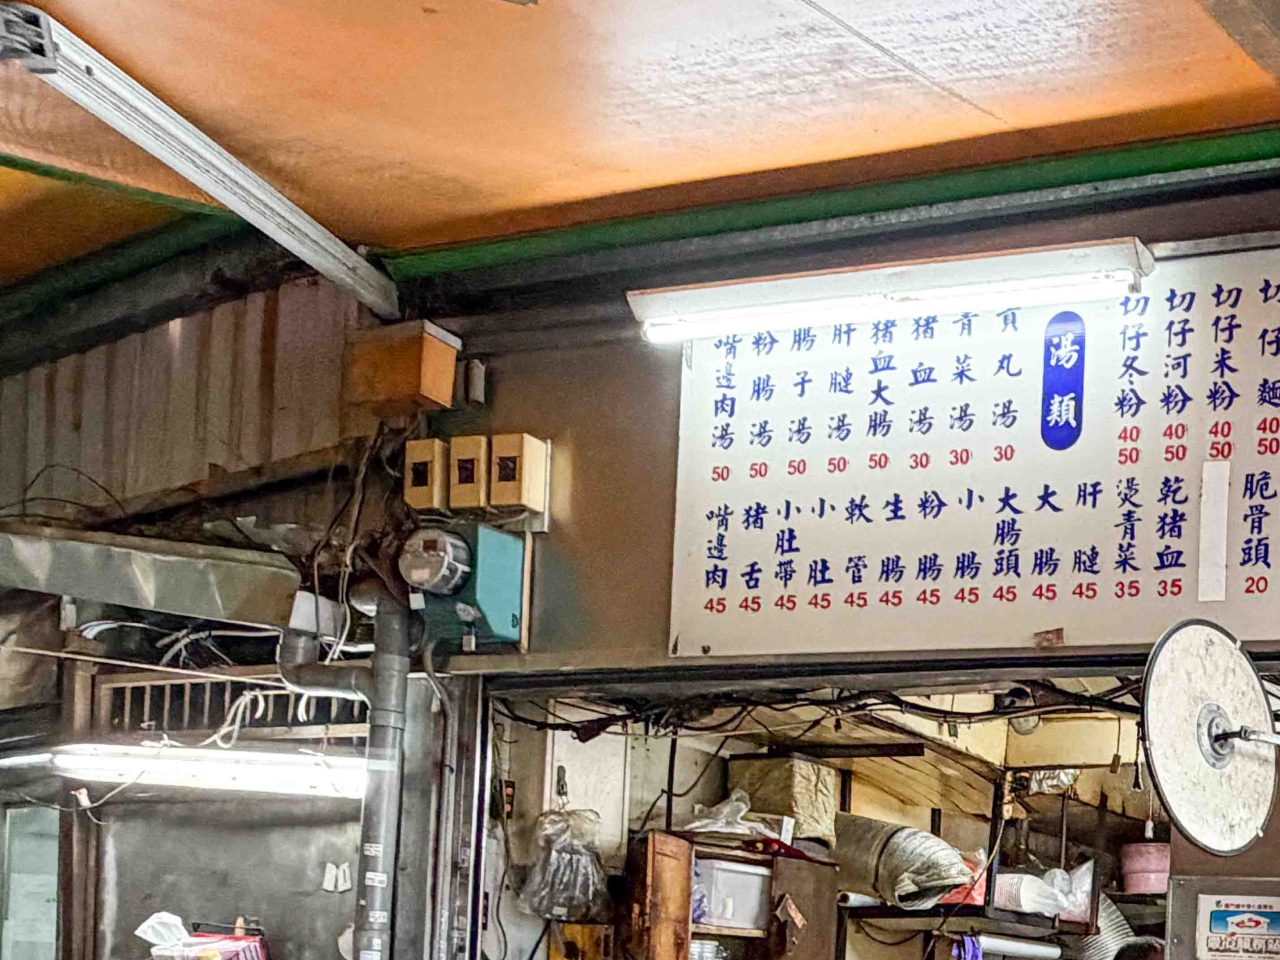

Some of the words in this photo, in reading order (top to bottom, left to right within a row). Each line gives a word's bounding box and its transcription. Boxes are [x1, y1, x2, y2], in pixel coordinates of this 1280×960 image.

[1159, 288, 1196, 415] 切仔河粉
[1206, 284, 1243, 412] 切仔米粉
[1114, 296, 1150, 418] 切仔冬粉
[950, 312, 979, 431] 青菜湯
[750, 331, 779, 447] 粉腸湯
[788, 327, 817, 444] 腸子湯
[1045, 332, 1080, 429] 湯類
[712, 334, 742, 449] 嘴邊肉湯
[1118, 426, 1140, 442] 40
[1163, 423, 1186, 440] 40
[1209, 421, 1232, 438] 40
[1257, 417, 1280, 434] 40
[993, 445, 1015, 462] 30
[1164, 444, 1187, 461] 50
[1209, 442, 1232, 459] 50
[1257, 438, 1280, 455] 50
[868, 453, 888, 469] 50
[910, 453, 930, 469] 30
[950, 449, 970, 465] 30
[1118, 447, 1139, 464] 50
[750, 462, 768, 478] 50
[788, 459, 806, 475] 50
[827, 457, 847, 473] 50
[712, 466, 730, 482] 50
[1113, 477, 1143, 574] 燙青菜
[1239, 471, 1277, 569] 脆骨頭
[878, 493, 906, 583] 生腸
[916, 490, 948, 582] 粉腸
[953, 488, 984, 580] 小腸
[992, 486, 1024, 579] 大腸頭
[1031, 484, 1064, 576] 大腸
[705, 504, 734, 590] 嘴邊肉
[774, 499, 801, 588] 小肚帶
[807, 497, 836, 587] 小肚
[844, 494, 873, 584] 軟管
[993, 585, 1017, 602] 45
[1032, 583, 1057, 600] 45
[1072, 582, 1098, 599] 45
[1114, 580, 1140, 598] 35
[1157, 578, 1182, 597] 35
[1245, 576, 1268, 594] 20
[774, 595, 797, 611] 45
[808, 593, 831, 609] 45
[844, 592, 868, 608] 45
[879, 590, 903, 607] 45
[916, 588, 941, 605] 45
[954, 587, 979, 603] 45
[704, 598, 726, 613] 45
[739, 596, 761, 612] 45
